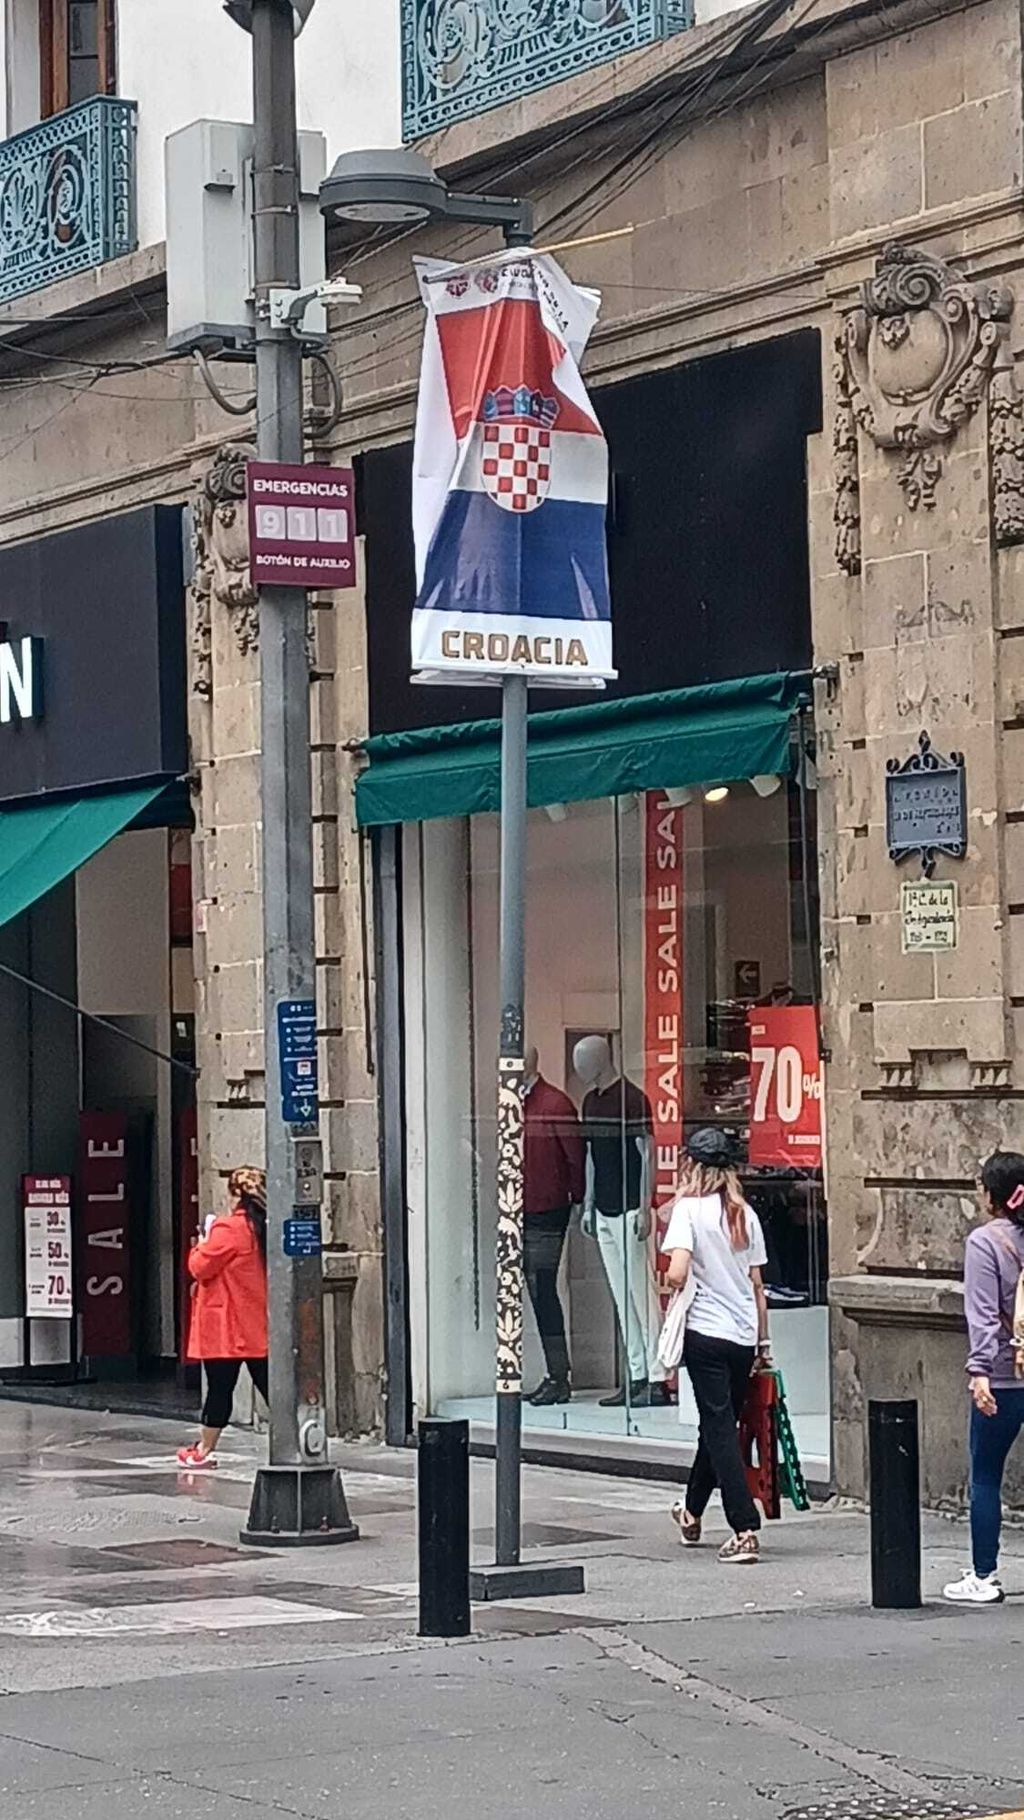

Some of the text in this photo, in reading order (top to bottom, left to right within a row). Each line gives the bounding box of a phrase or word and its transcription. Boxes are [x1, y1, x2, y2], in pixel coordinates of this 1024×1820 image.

[253, 479, 348, 497] EMERGENCIAS
[262, 510, 337, 538] 911
[256, 554, 351, 569] BOTÓN DE AUXILIO
[441, 630, 588, 666] CROACIA
[657, 884, 677, 993] SALE
[657, 1014, 679, 1124] SALE
[751, 1045, 823, 1123] 70%
[86, 1138, 125, 1296] SALE
